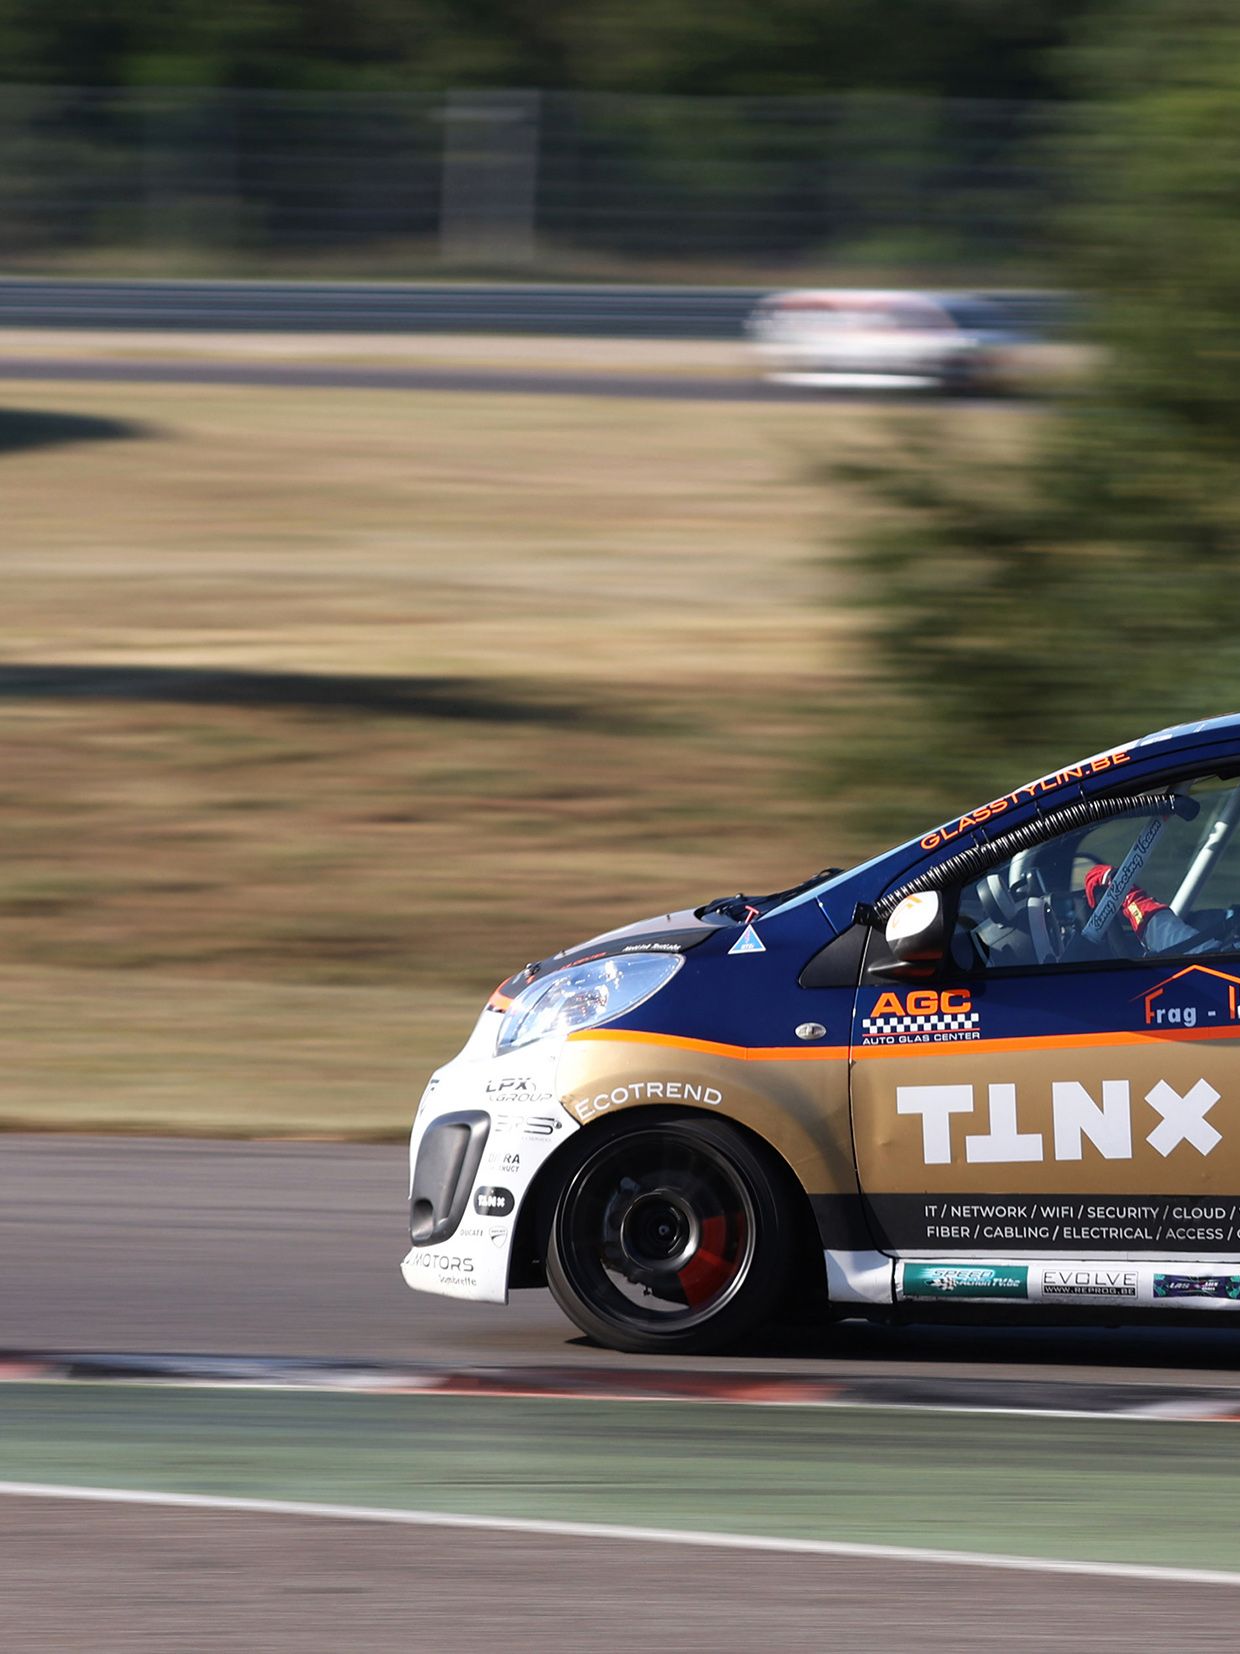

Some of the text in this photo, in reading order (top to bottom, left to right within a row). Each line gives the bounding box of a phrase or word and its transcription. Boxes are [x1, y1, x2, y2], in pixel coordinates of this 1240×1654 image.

[920, 749, 1132, 850] GLASSTYLIN.BE
[870, 989, 972, 1018] AGC
[863, 1031, 980, 1045] AUTO GLAS CENTER
[574, 1082, 723, 1121] ECOTREND
[925, 1205, 937, 1217] IT
[951, 1205, 1027, 1218] NETWORK
[1040, 1206, 1074, 1218] WIFI
[1087, 1206, 1159, 1219] SECURITY
[1172, 1207, 1226, 1219] CLOUD
[926, 1225, 970, 1238] FIBER
[983, 1226, 1049, 1239] CABLING
[1063, 1227, 1153, 1240] ELECTRICAL
[1165, 1228, 1224, 1240] ACCESS
[1044, 1271, 1136, 1286] EVOLVE
